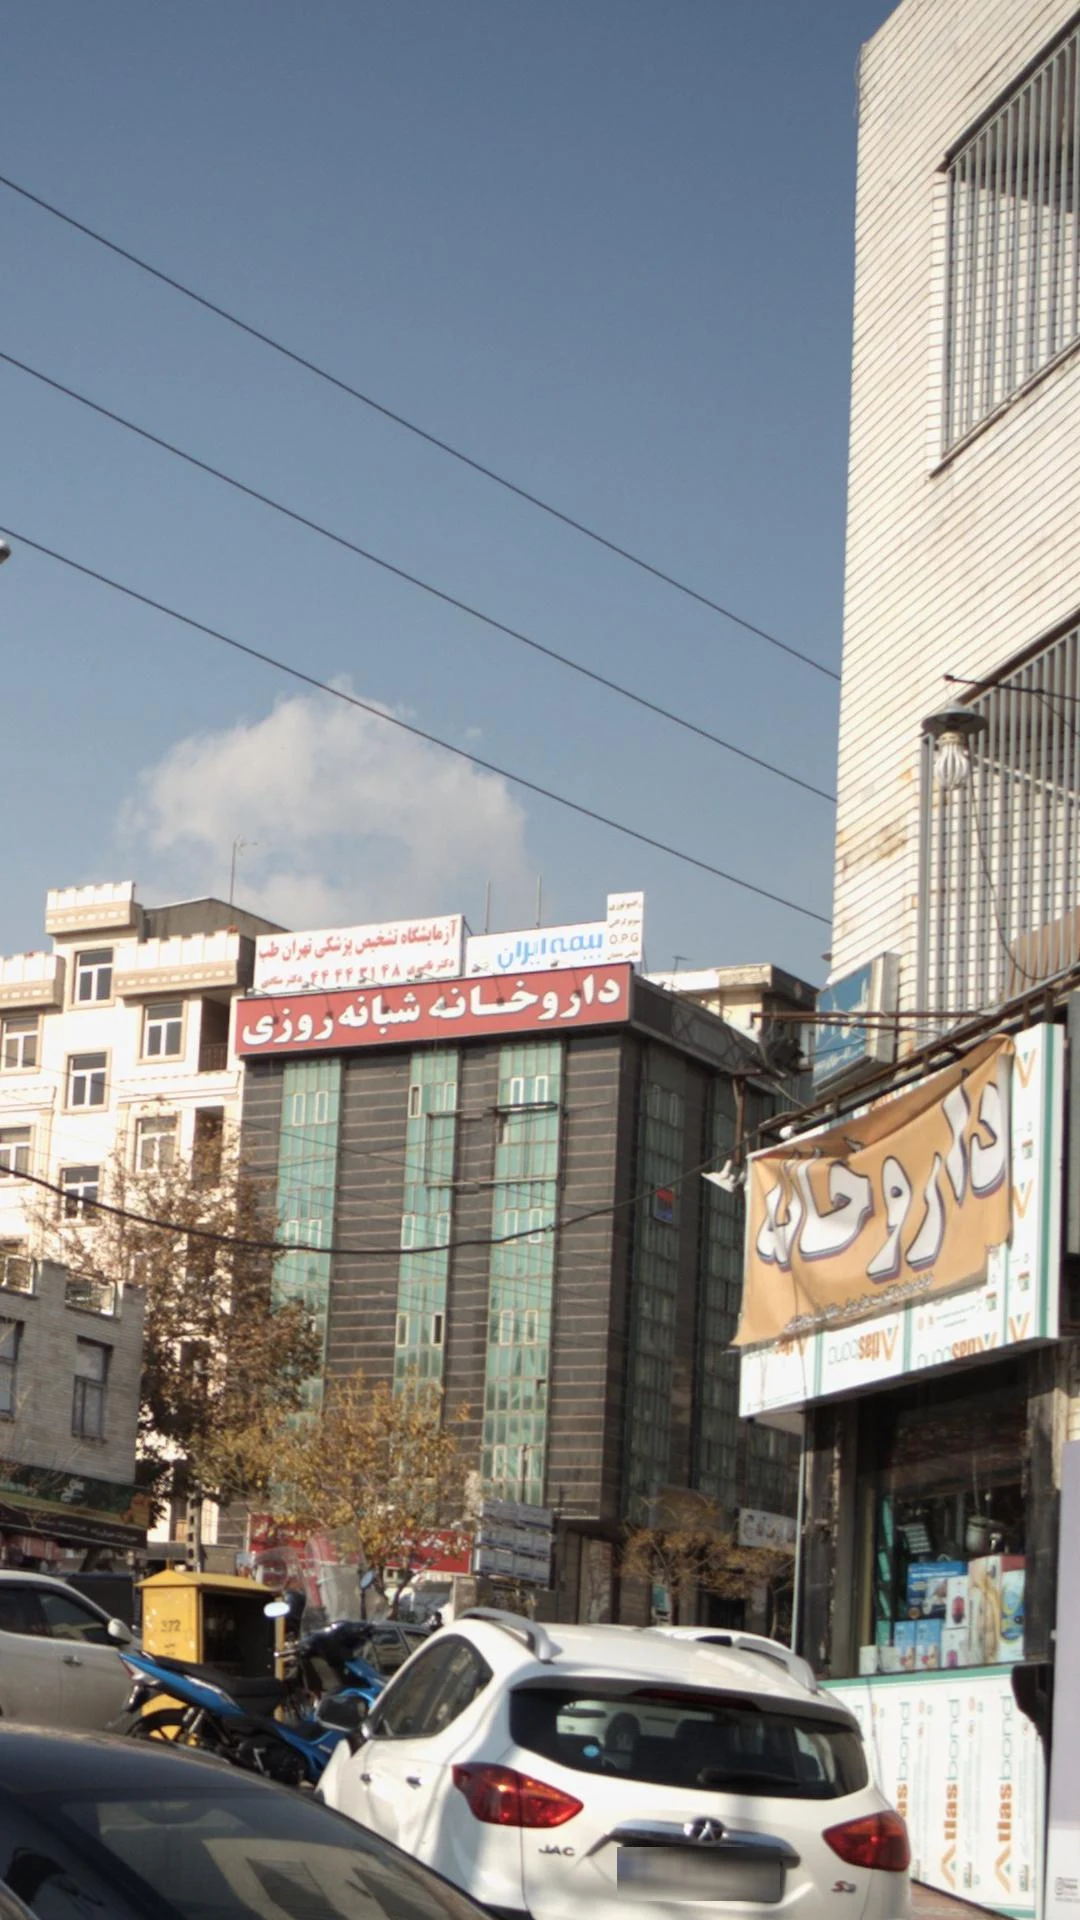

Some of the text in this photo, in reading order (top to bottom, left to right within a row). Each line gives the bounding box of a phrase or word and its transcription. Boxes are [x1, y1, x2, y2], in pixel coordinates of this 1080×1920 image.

[259, 919, 457, 964] آزمایشگاه تشخیص پزشکی تهران طب
[497, 937, 547, 969] ایران
[242, 973, 621, 1046] داروخانه شبانه روزی
[538, 1845, 575, 1856] JAC
